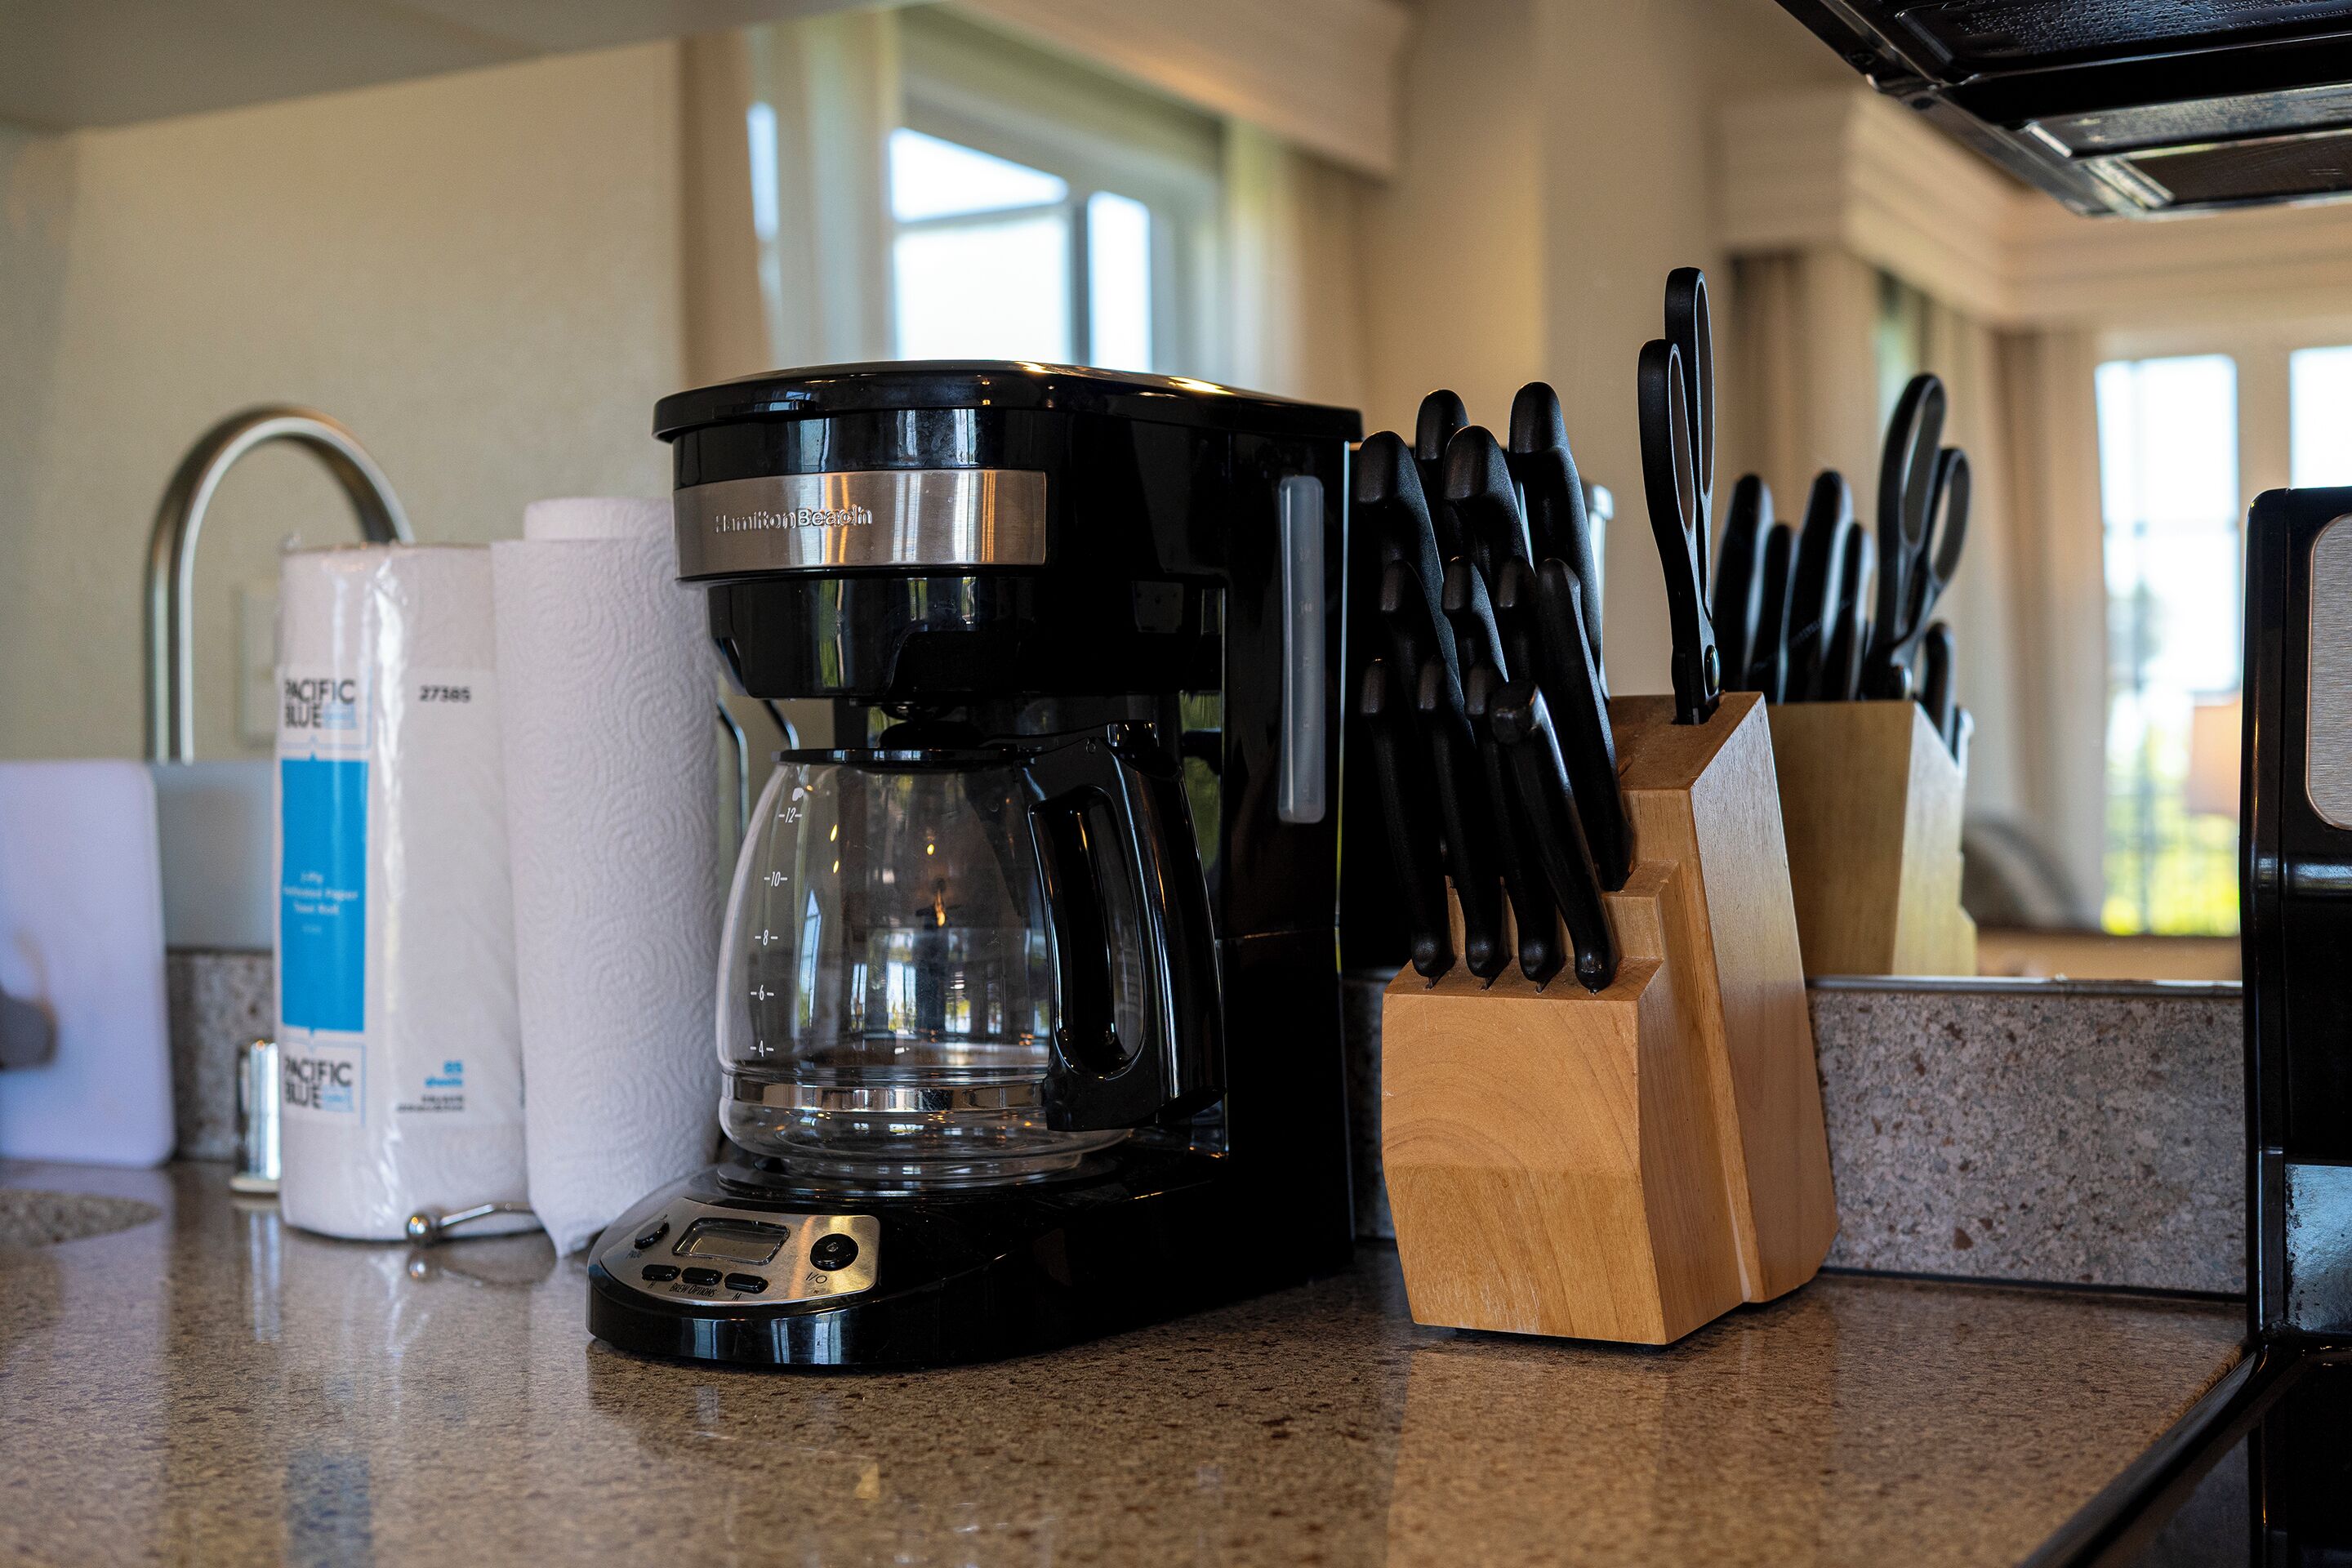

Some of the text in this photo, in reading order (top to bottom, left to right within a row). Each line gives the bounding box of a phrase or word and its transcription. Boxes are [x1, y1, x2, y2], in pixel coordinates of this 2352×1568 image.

[284, 679, 355, 704] PACIFIC
[285, 703, 322, 728] BLUE
[284, 1056, 352, 1087] PACIFIC
[285, 1080, 321, 1109] BLUE
[669, 1283, 717, 1298] BREW OPTIONS
